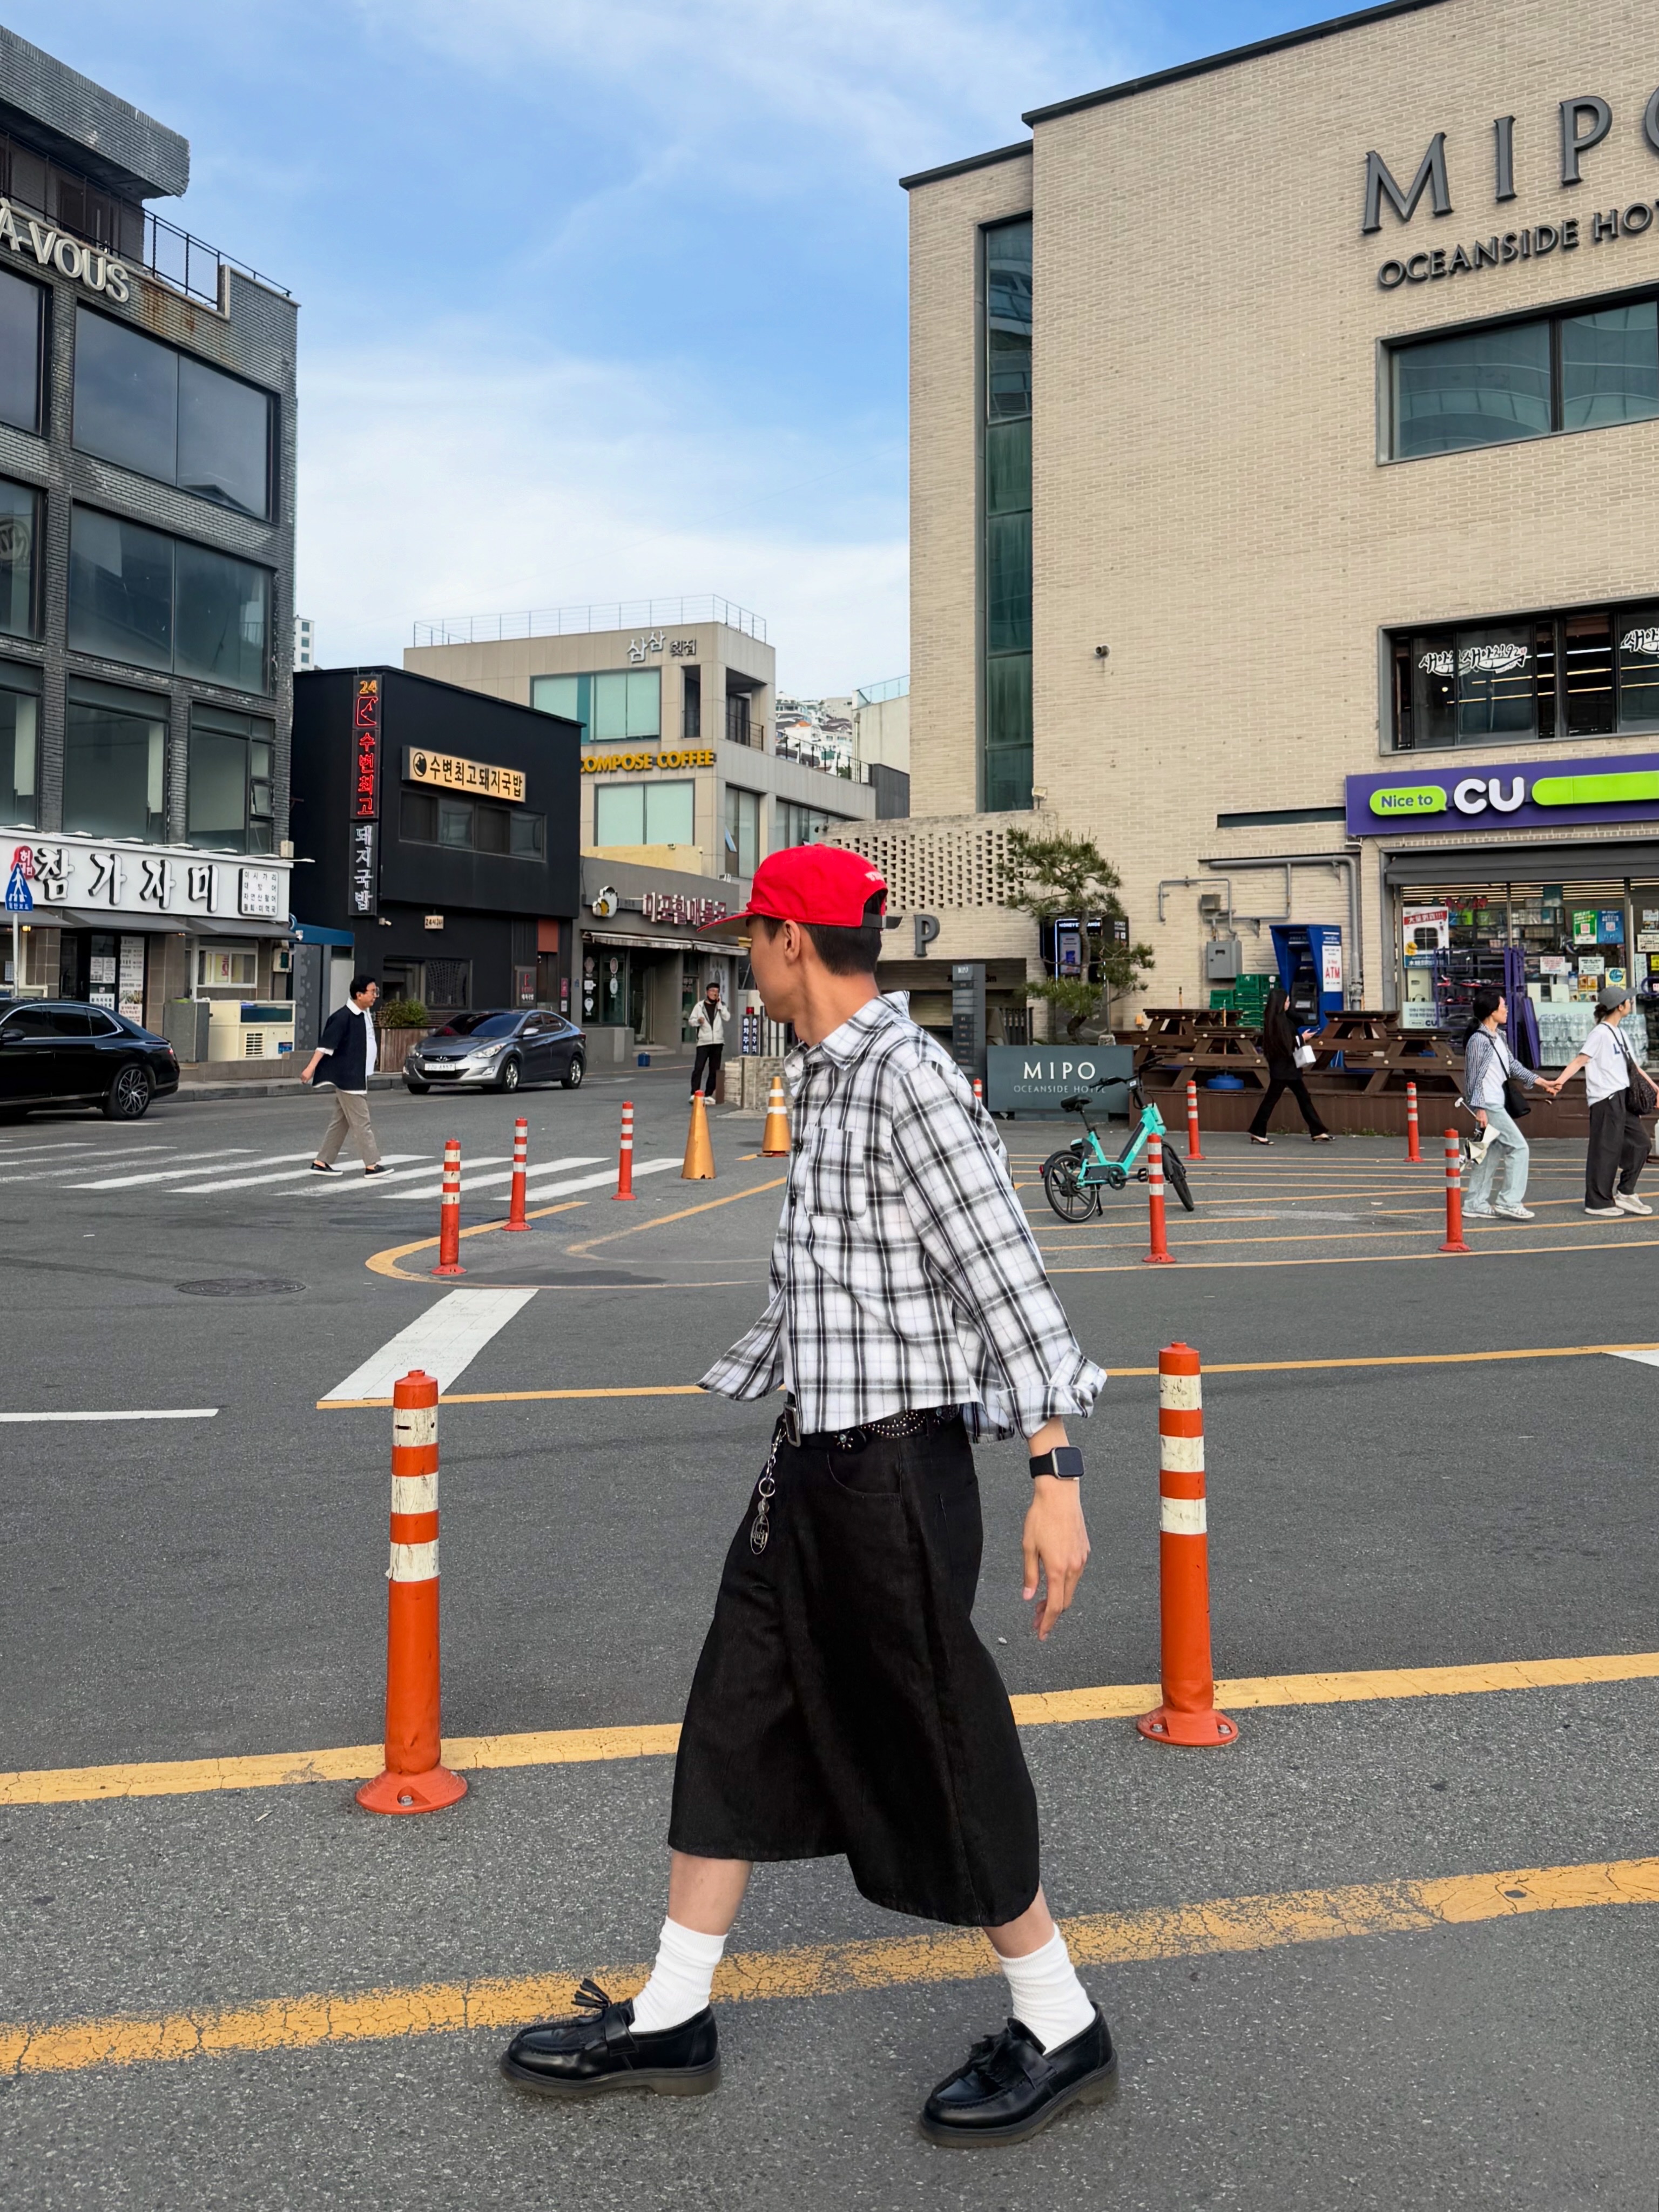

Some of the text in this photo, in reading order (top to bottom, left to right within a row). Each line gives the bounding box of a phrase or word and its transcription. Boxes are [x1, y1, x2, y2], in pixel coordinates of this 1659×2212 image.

[1363, 86, 1659, 234] MIP
[1378, 199, 1659, 287] OCEANSIDE HO
[627, 630, 697, 663] 삼삼 횟집
[360, 680, 377, 694] 24
[358, 732, 375, 815] 수변최고
[657, 748, 714, 768] COFFEE
[1381, 777, 1525, 814] Nice to CU
[34, 847, 220, 913] 참가자미
[355, 826, 373, 911] 돼지국밥
[914, 914, 940, 956] P
[1325, 967, 1340, 979] ATM
[1014, 1085, 1068, 1093] OCEANSIDE
[1023, 1061, 1095, 1080] MIPO
